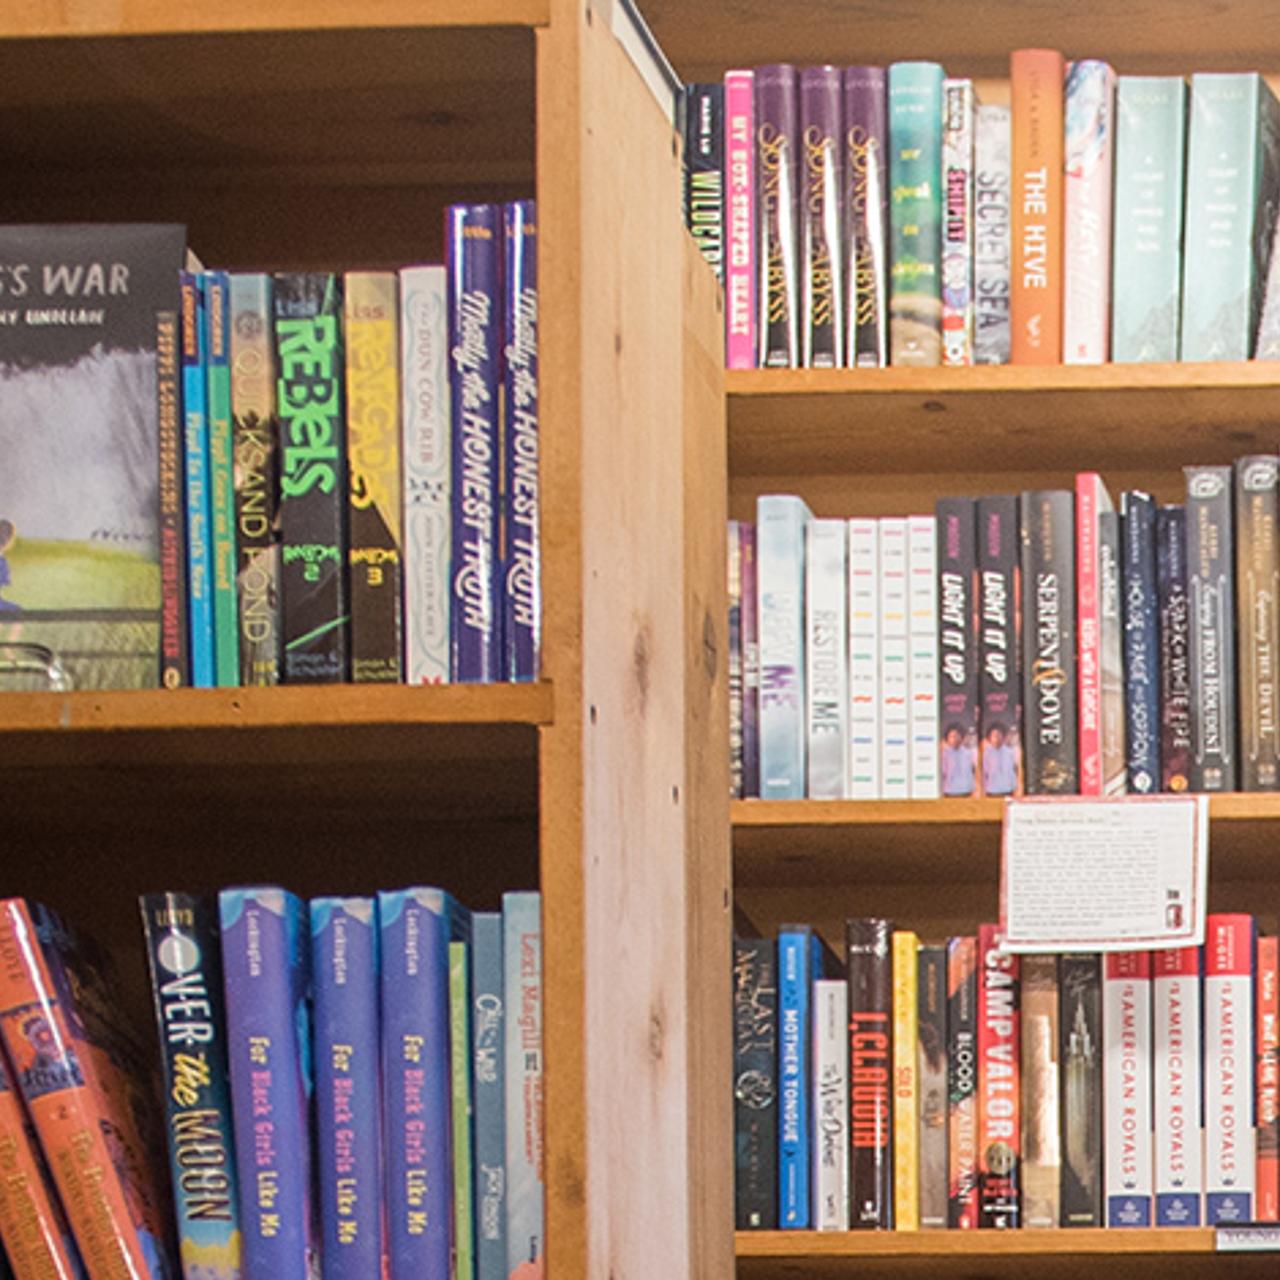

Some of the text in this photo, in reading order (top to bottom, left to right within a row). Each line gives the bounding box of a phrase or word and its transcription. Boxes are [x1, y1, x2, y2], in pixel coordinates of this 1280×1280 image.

[1023, 168, 1047, 288] THE HIVE
[460, 415, 492, 527] HONEST
[455, 535, 489, 633] TRUTH
[173, 1050, 211, 1108] the
[985, 948, 1013, 1138] CAMP VALOR
[1121, 999, 1136, 1175] AMERICAN ROYALS
[172, 1108, 232, 1223] MOON
[249, 1036, 279, 1238] For Black Girls Like Me
